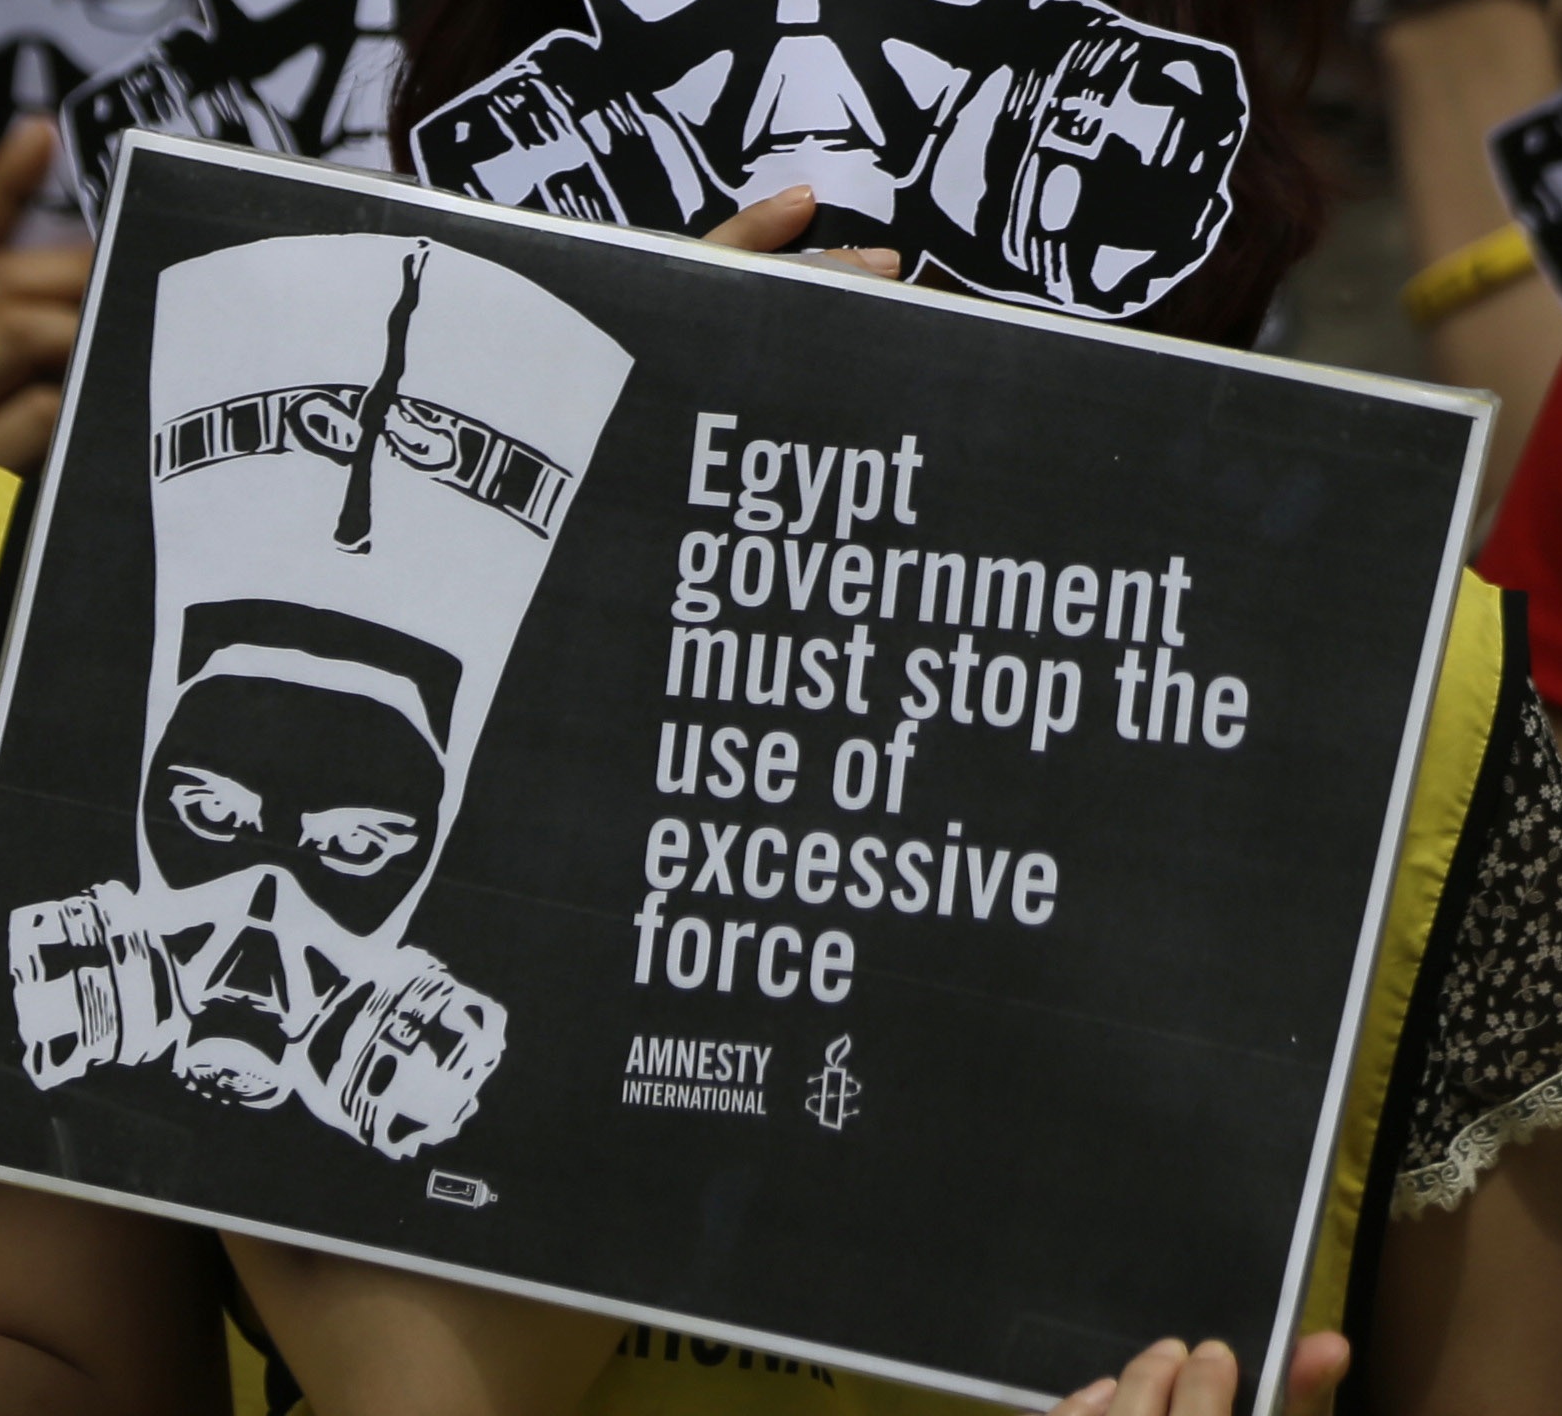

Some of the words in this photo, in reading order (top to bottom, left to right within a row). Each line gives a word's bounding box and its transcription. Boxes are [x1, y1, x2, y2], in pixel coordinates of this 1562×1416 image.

[688, 412, 923, 539] Egypt
[671, 531, 1191, 646] government
[666, 625, 875, 714] must
[901, 634, 1081, 751] stop
[1115, 647, 1248, 748] the
[656, 722, 799, 803] use
[833, 720, 919, 813] of
[645, 818, 1057, 924] excessive
[634, 891, 854, 1002] force
[621, 1080, 767, 1115] INTERNATIONAL
[624, 1036, 773, 1085] AMNESTY
